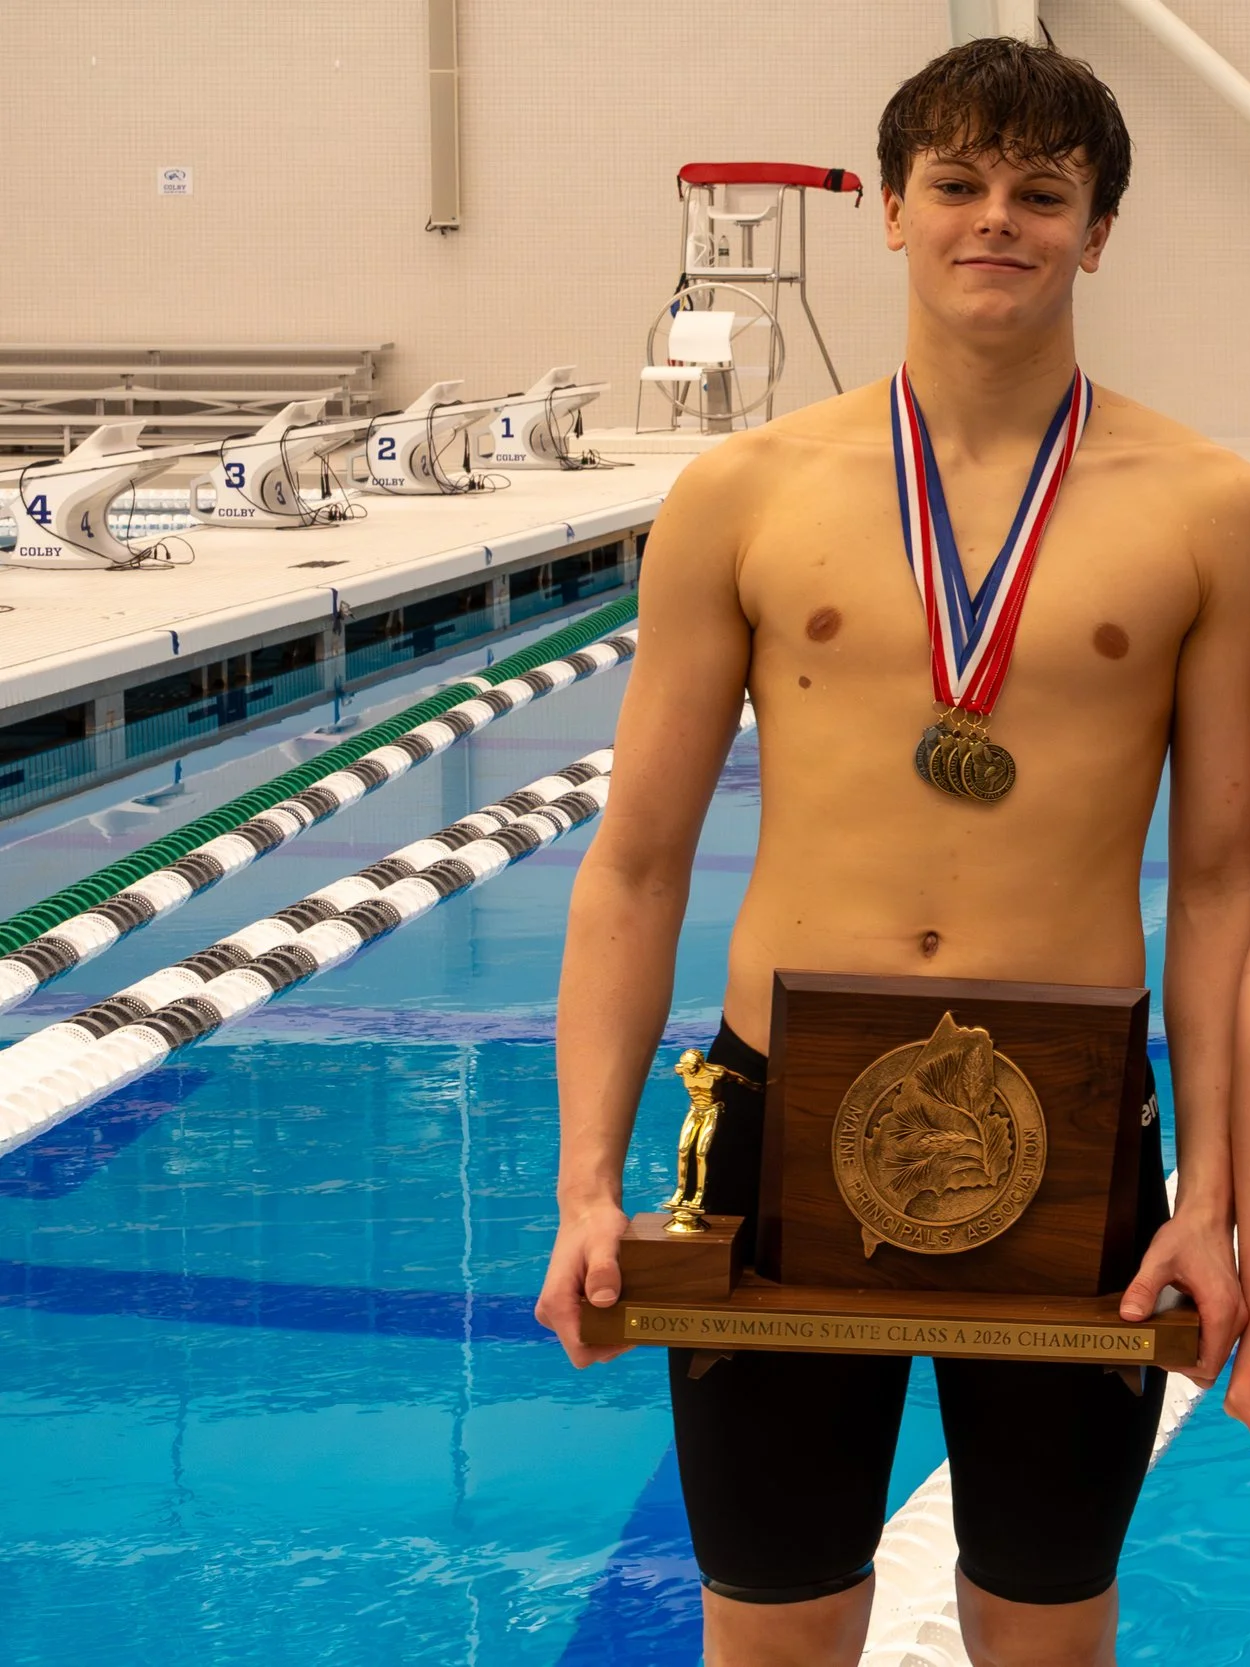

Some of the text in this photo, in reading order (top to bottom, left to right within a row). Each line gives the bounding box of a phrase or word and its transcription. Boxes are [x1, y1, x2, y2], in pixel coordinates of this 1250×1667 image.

[501, 417, 514, 438] 1
[377, 437, 396, 460] 2
[496, 454, 526, 462] COLBY
[225, 463, 245, 488] 3
[372, 478, 405, 486] COLBY
[274, 481, 286, 505] 3
[26, 495, 52, 524] 4
[218, 508, 256, 517] COLBY
[81, 511, 94, 538] 4
[19, 547, 62, 557] COLBY
[838, 1105, 863, 1169] MAINE
[967, 1128, 1041, 1241] ASSOCIATION
[639, 1315, 1142, 1351] BOYS' SWIMMING STATE CLASS A 2026 CHAMPIONS
